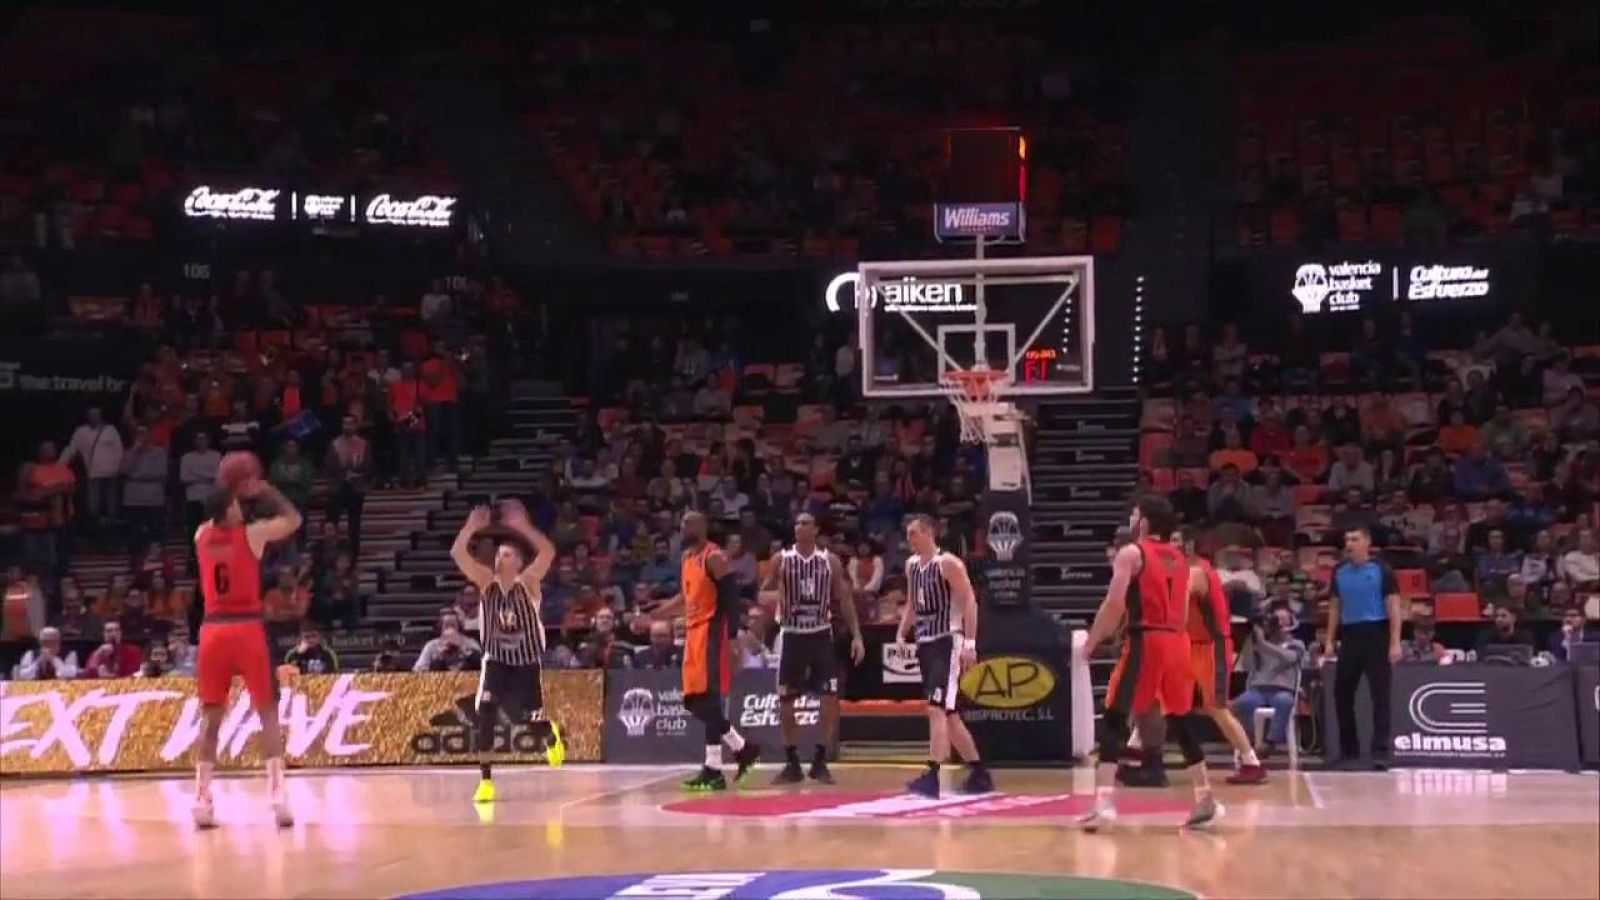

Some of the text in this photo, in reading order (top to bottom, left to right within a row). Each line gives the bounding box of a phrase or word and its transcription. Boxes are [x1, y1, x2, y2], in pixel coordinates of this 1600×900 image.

[944, 208, 1010, 228] Williams
[1329, 260, 1381, 276] valencia
[1410, 265, 1473, 281] Cultura
[884, 276, 962, 304] aiken
[1329, 277, 1373, 291] basket
[1408, 282, 1489, 300] Esfuerzo
[1329, 293, 1360, 305] club
[214, 561, 229, 596] 6
[975, 662, 1040, 698] AP
[0, 681, 184, 767] EXT
[655, 717, 687, 731] club
[412, 723, 563, 753] adida
[1394, 733, 1507, 751] elmusa
